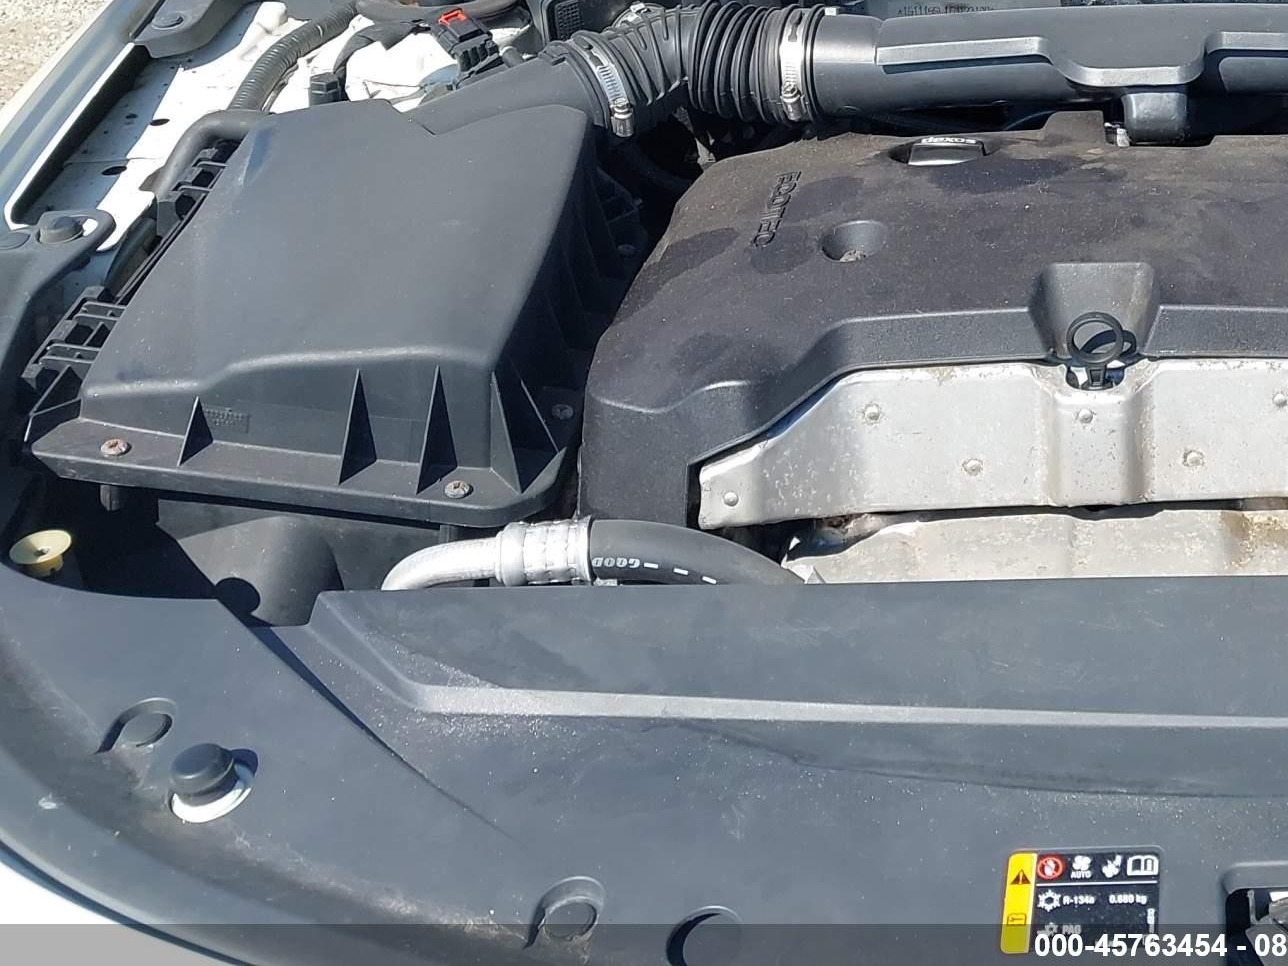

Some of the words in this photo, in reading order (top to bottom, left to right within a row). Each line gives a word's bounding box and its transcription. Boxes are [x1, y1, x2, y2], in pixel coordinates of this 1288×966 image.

[921, 136, 977, 145] dexos
[591, 557, 641, 569] GOOD
[1070, 870, 1092, 879] AUTO
[1062, 896, 1095, 905] R-134a
